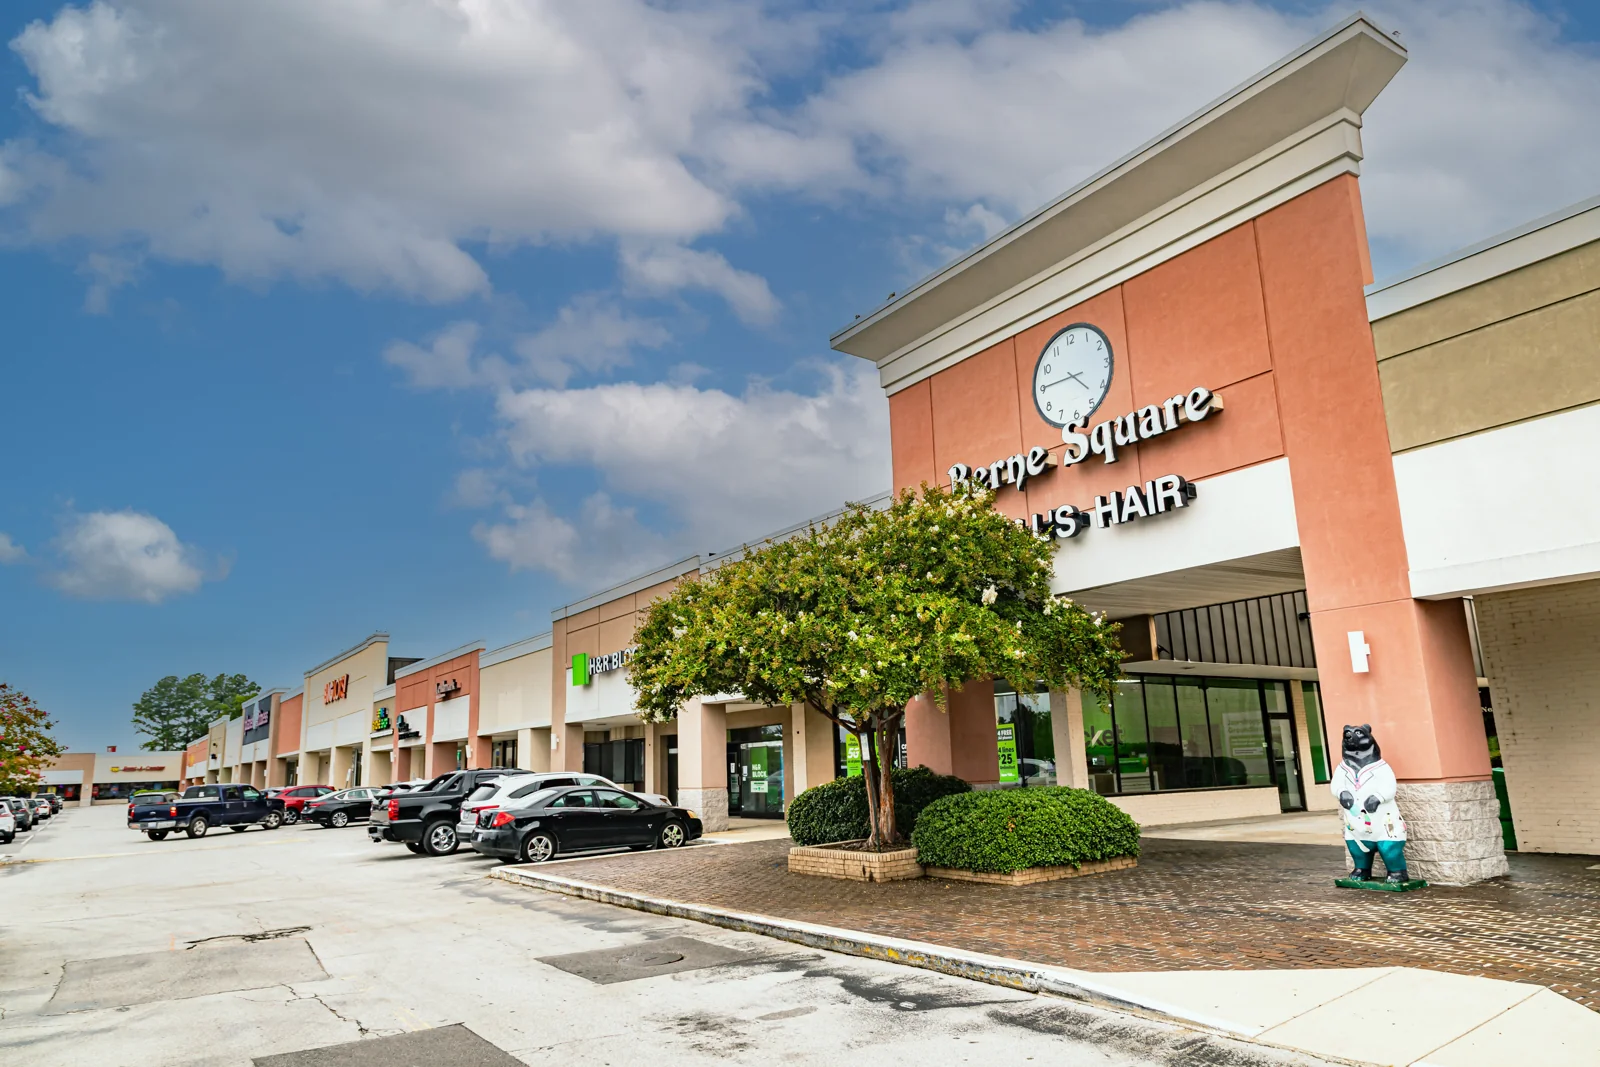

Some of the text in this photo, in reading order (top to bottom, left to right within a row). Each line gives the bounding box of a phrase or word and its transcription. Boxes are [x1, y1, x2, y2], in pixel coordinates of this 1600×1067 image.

[1066, 333, 1075, 346] 12
[1096, 340, 1103, 351] 2
[1053, 346, 1060, 357] 11
[1103, 357, 1110, 369] 3
[1043, 364, 1052, 375] 10
[1040, 384, 1046, 395] 9
[1099, 379, 1106, 389] 4
[1045, 401, 1053, 412] 8
[1088, 397, 1095, 409] 5
[1058, 409, 1064, 420] 7
[1073, 409, 1080, 420] 6
[946, 386, 1214, 499] Berne Square
[1094, 474, 1186, 528] HAIR
[589, 654, 609, 676] H&R
[847, 747, 860, 759] 5G
